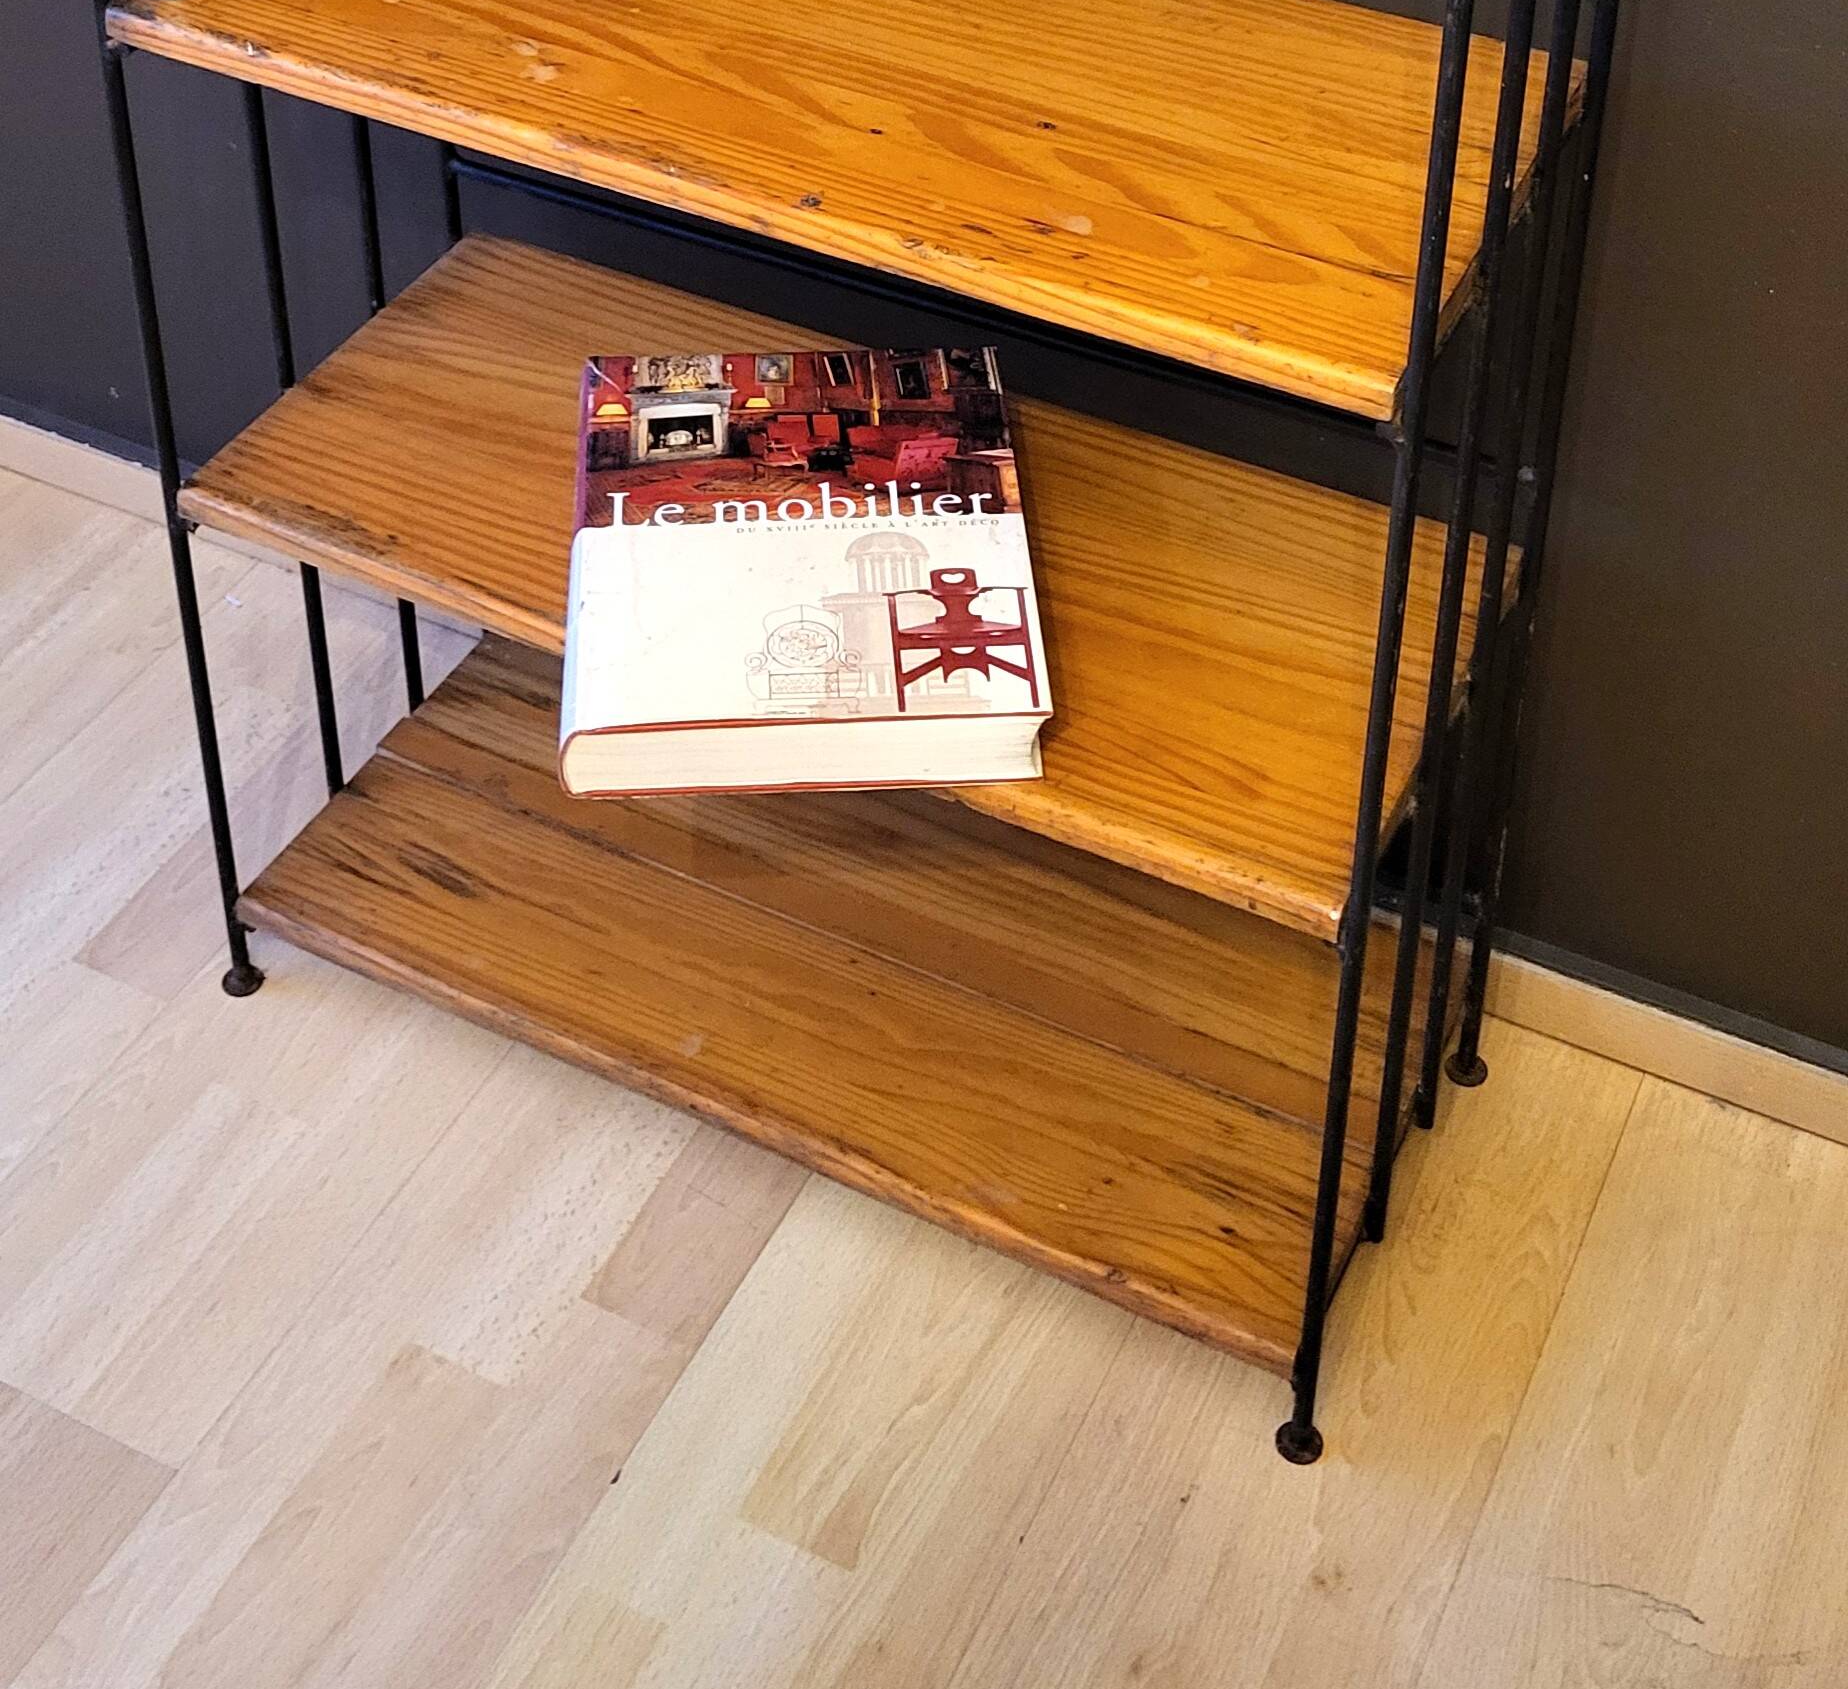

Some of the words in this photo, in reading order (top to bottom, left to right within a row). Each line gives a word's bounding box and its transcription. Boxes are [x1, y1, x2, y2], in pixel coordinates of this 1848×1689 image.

[606, 491, 686, 527] Le
[712, 479, 993, 524] mobilier
[736, 526, 757, 534] DU
[824, 520, 879, 530] SIÈCLE
[905, 519, 949, 528] L'ART
[959, 518, 1001, 526] DÉCO
